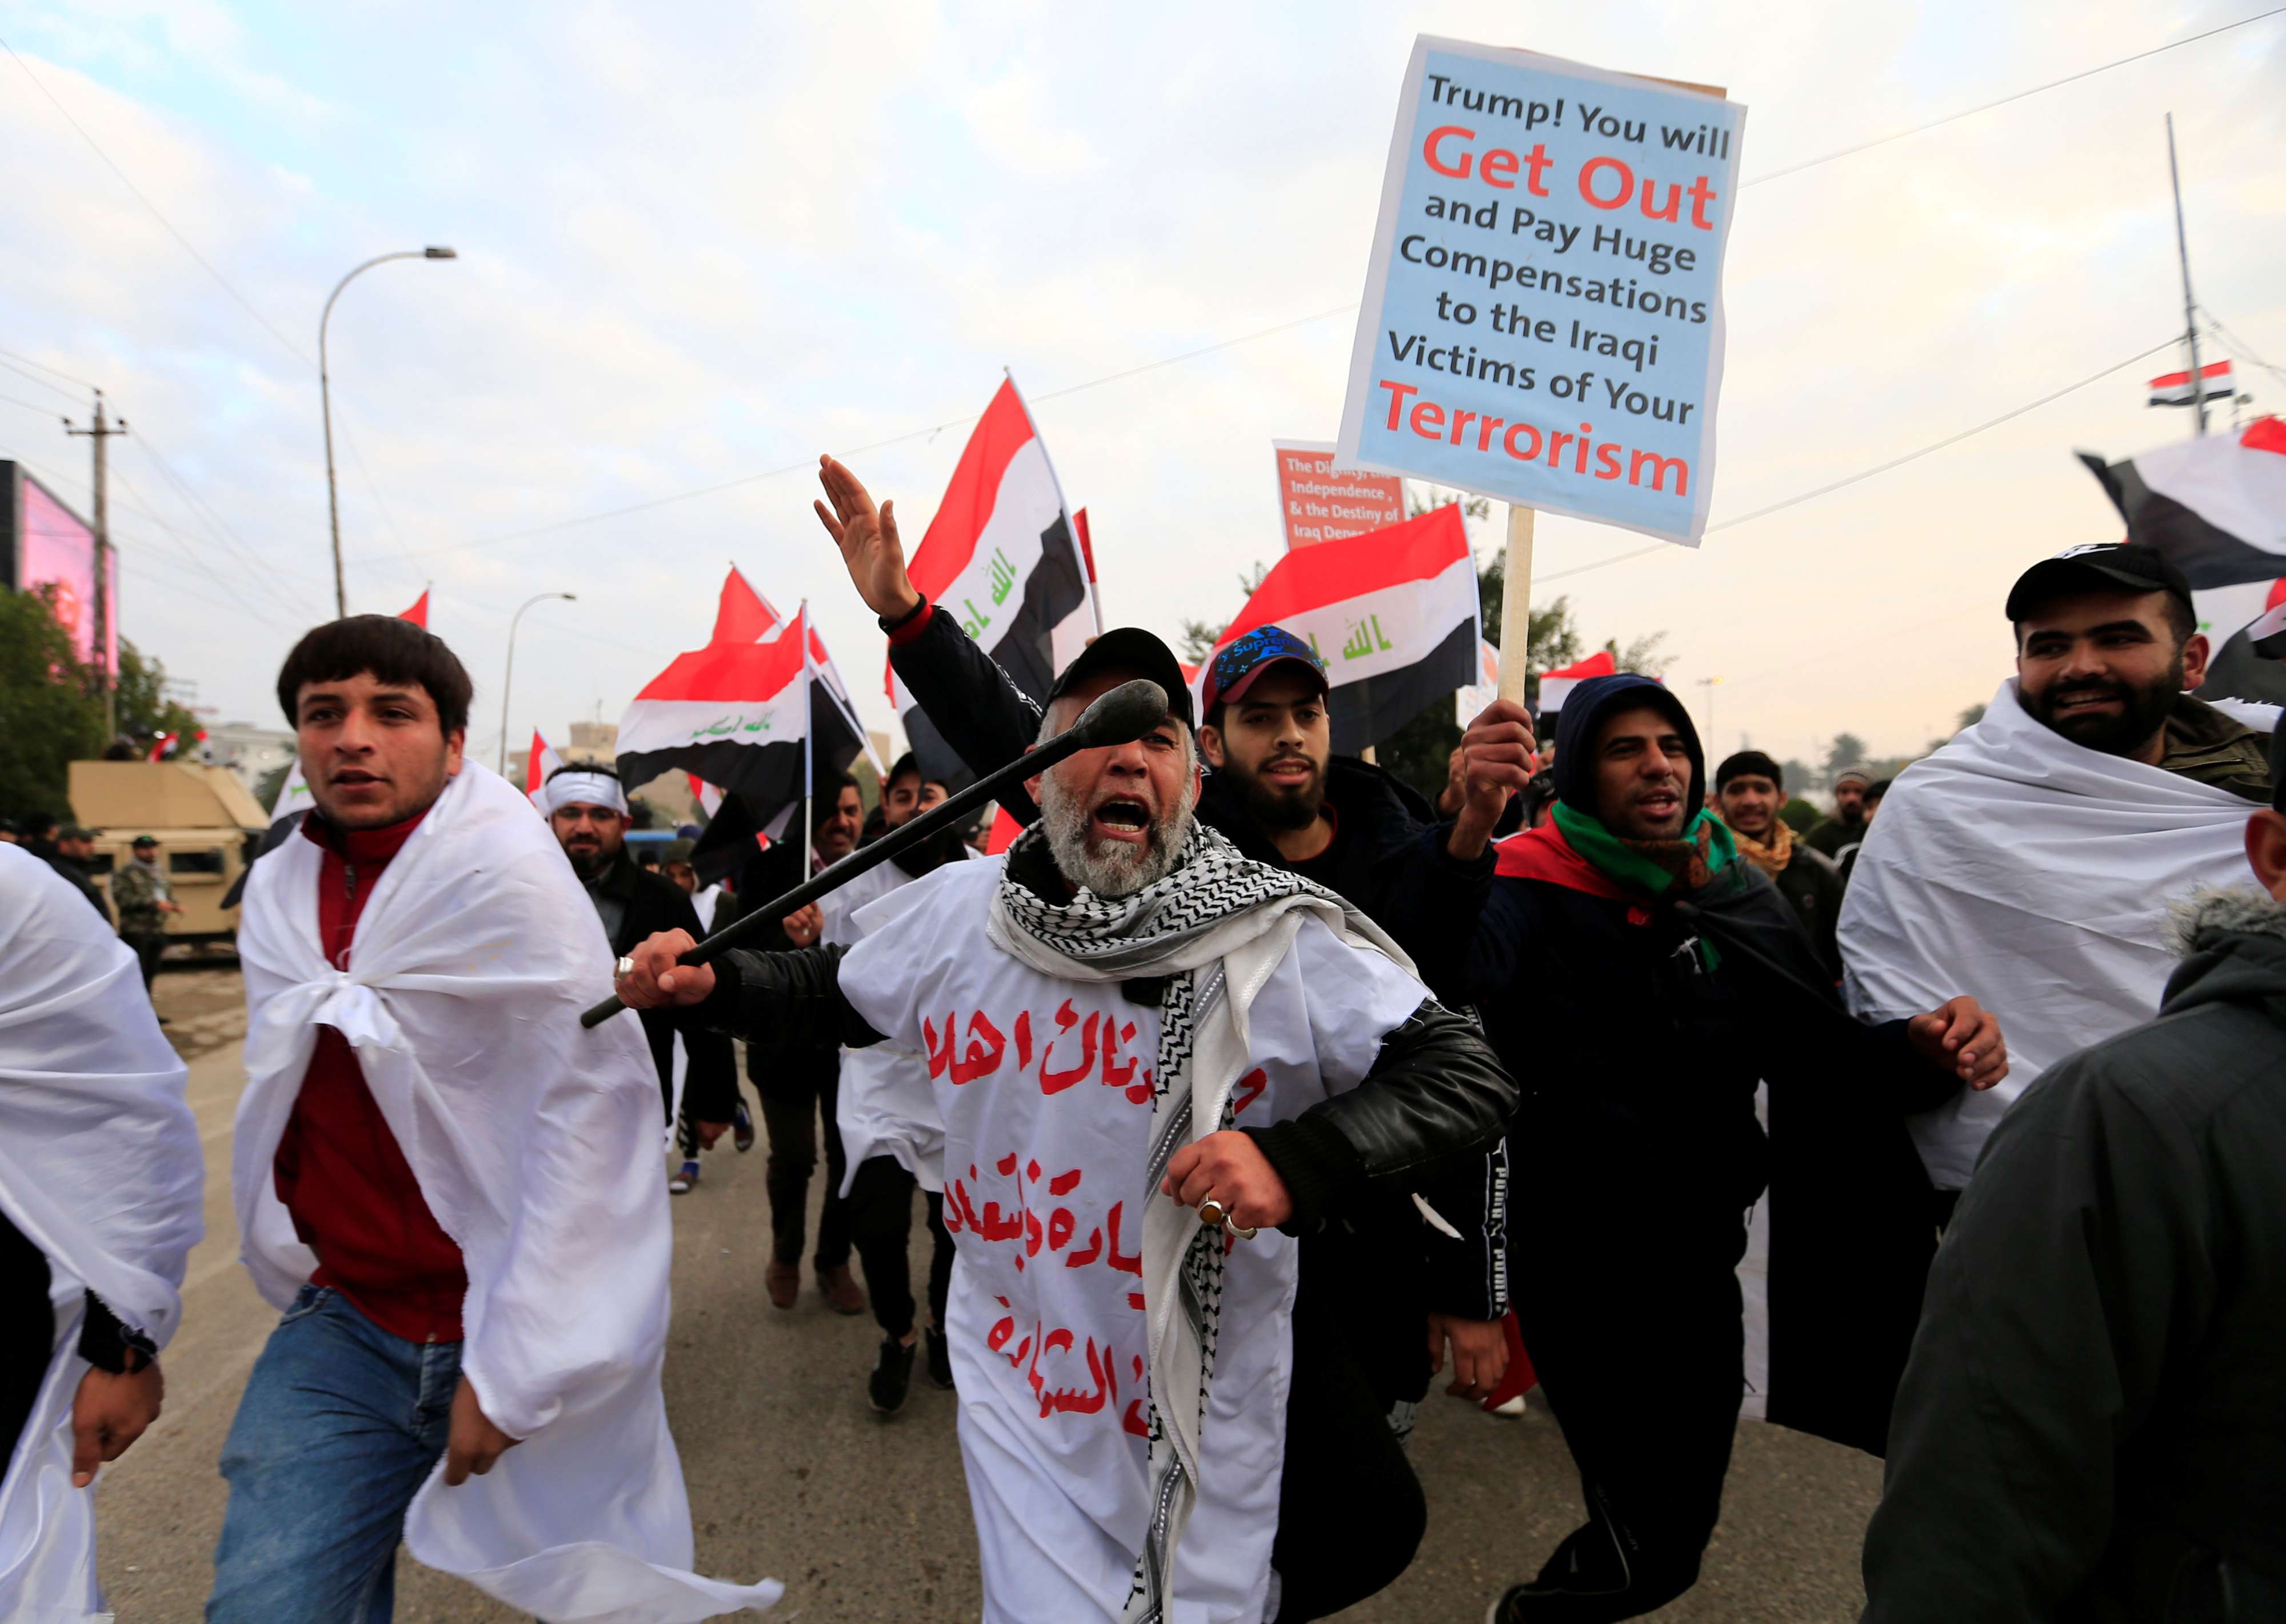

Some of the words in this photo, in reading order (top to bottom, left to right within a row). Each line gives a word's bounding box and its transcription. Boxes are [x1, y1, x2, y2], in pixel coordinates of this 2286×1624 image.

[1428, 74, 1564, 131] Trump!
[1578, 103, 1646, 143] You
[1661, 125, 1729, 159] will
[1423, 125, 1554, 198] Get
[1578, 156, 1717, 230] Out
[1425, 196, 1499, 230] and
[1512, 207, 1581, 254] Pay
[1593, 224, 1696, 275] Huge
[1401, 235, 1706, 323] Compensations
[1436, 291, 1477, 325] to
[1490, 303, 1556, 343] the
[1570, 319, 1659, 373] Iraqi
[1388, 330, 1535, 390] Victims
[1549, 372, 1594, 402] of
[1604, 378, 1694, 425] Your
[1286, 458, 1312, 473] The
[1380, 379, 1689, 497] Terrorism
[1290, 501, 1302, 515] &
[1306, 502, 1329, 518] the
[1332, 505, 1382, 525] Destiny
[1385, 507, 1399, 522] of
[1292, 479, 1385, 500] Independence
[1294, 523, 1322, 542] Iraq
[1233, 637, 1308, 657] Suprem
[1491, 1167, 1507, 1219] PUMA
[1493, 1248, 1507, 1303] PUMA
